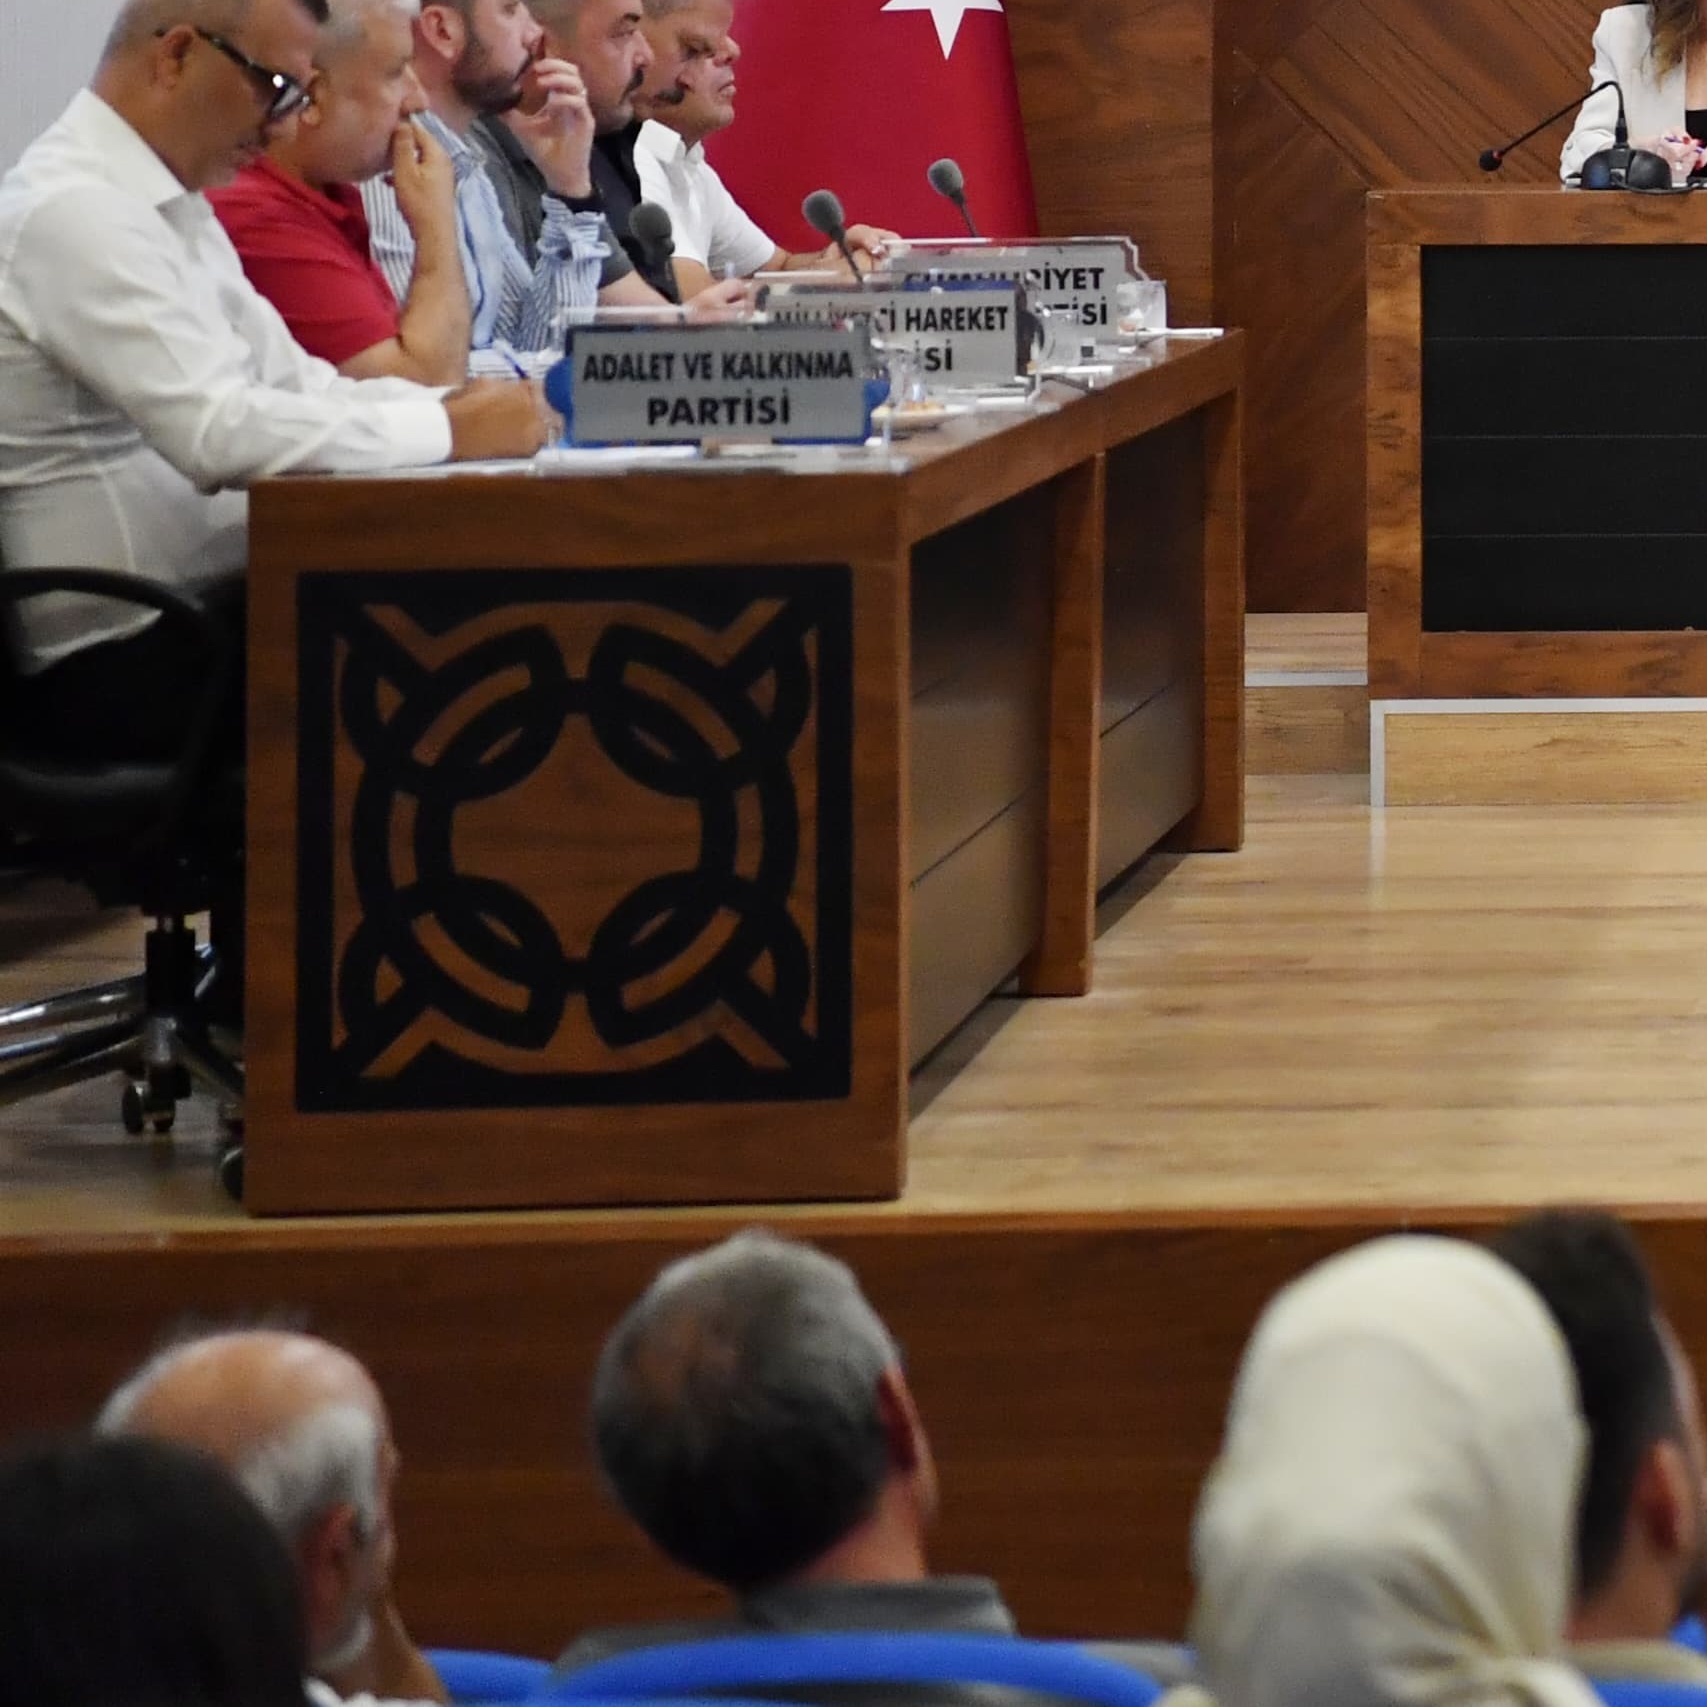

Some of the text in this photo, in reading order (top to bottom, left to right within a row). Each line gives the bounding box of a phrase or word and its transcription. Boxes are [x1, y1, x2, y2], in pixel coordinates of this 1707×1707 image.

[905, 305, 1008, 332] HAREKET
[583, 350, 853, 382] ADALET VE KALKINMA
[649, 388, 790, 427] PARTİSİ
